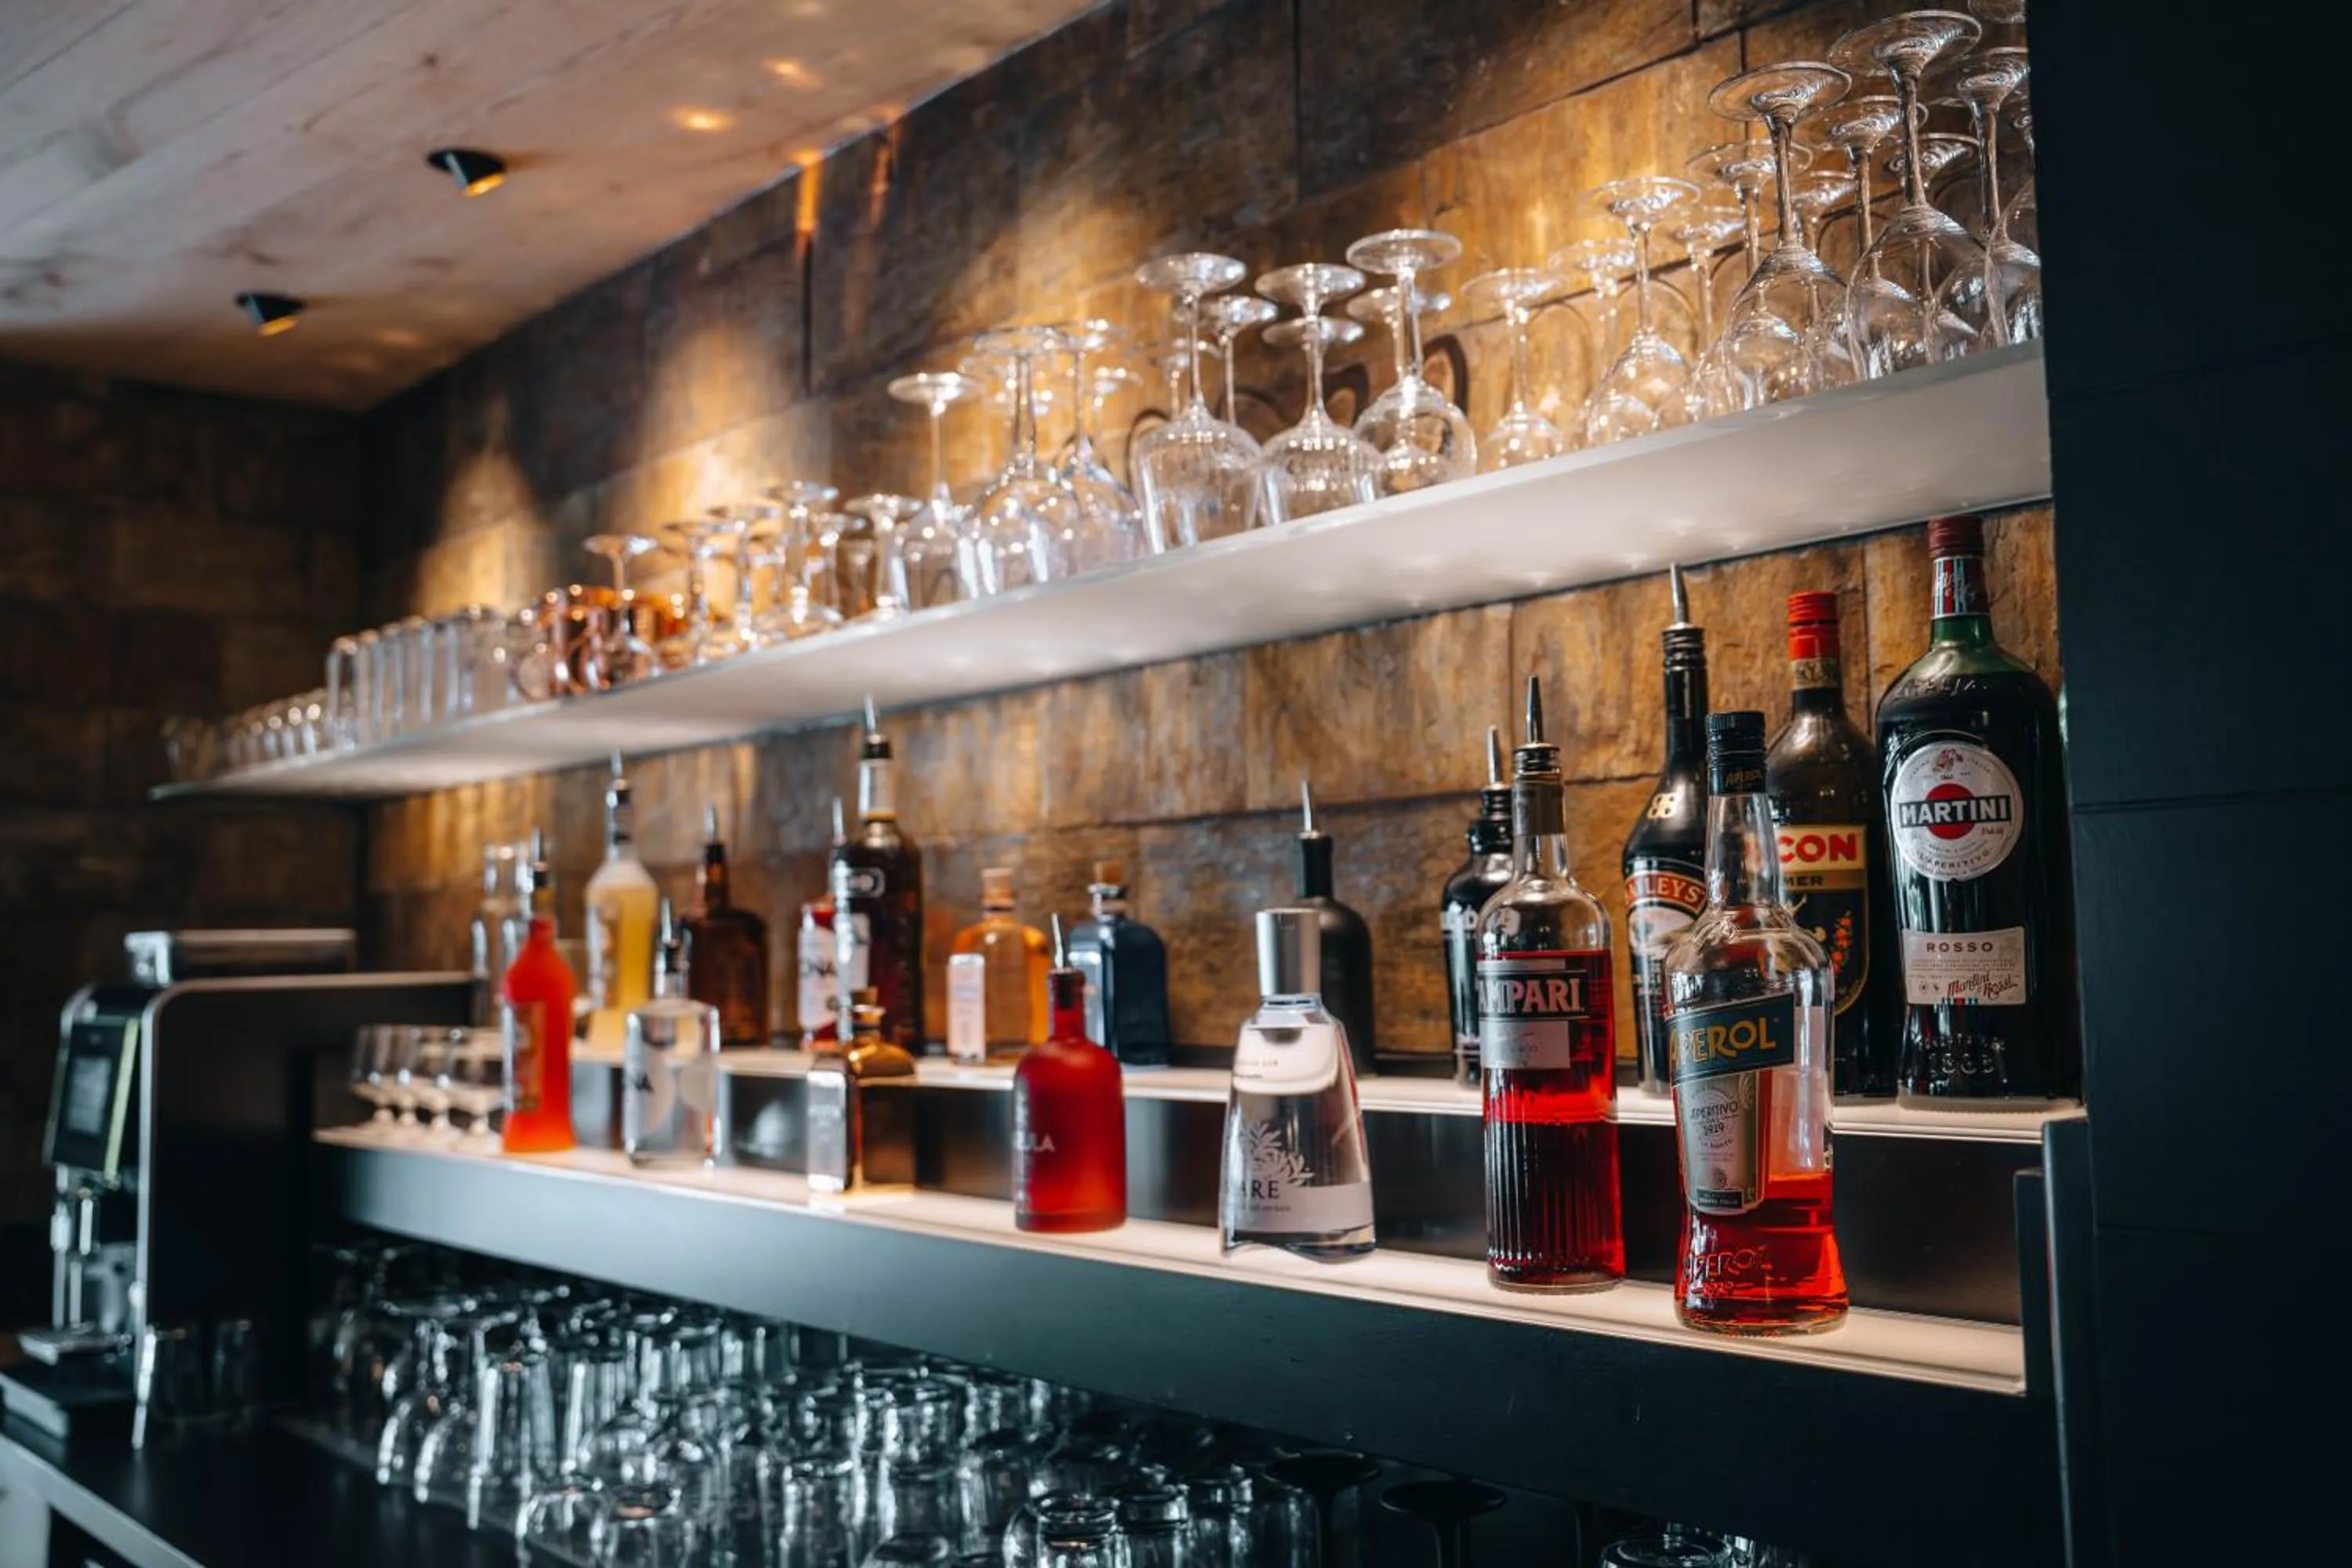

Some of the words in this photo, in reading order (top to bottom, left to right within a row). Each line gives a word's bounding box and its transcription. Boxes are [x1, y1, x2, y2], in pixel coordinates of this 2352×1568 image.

[1900, 798, 2007, 824] MARTINI
[1778, 833, 1857, 862] CON
[1784, 875, 1824, 887] MER
[1926, 942, 1993, 953] ROSSO
[1475, 978, 1581, 1014] AMPARI
[1669, 1016, 1777, 1071] APEROL
